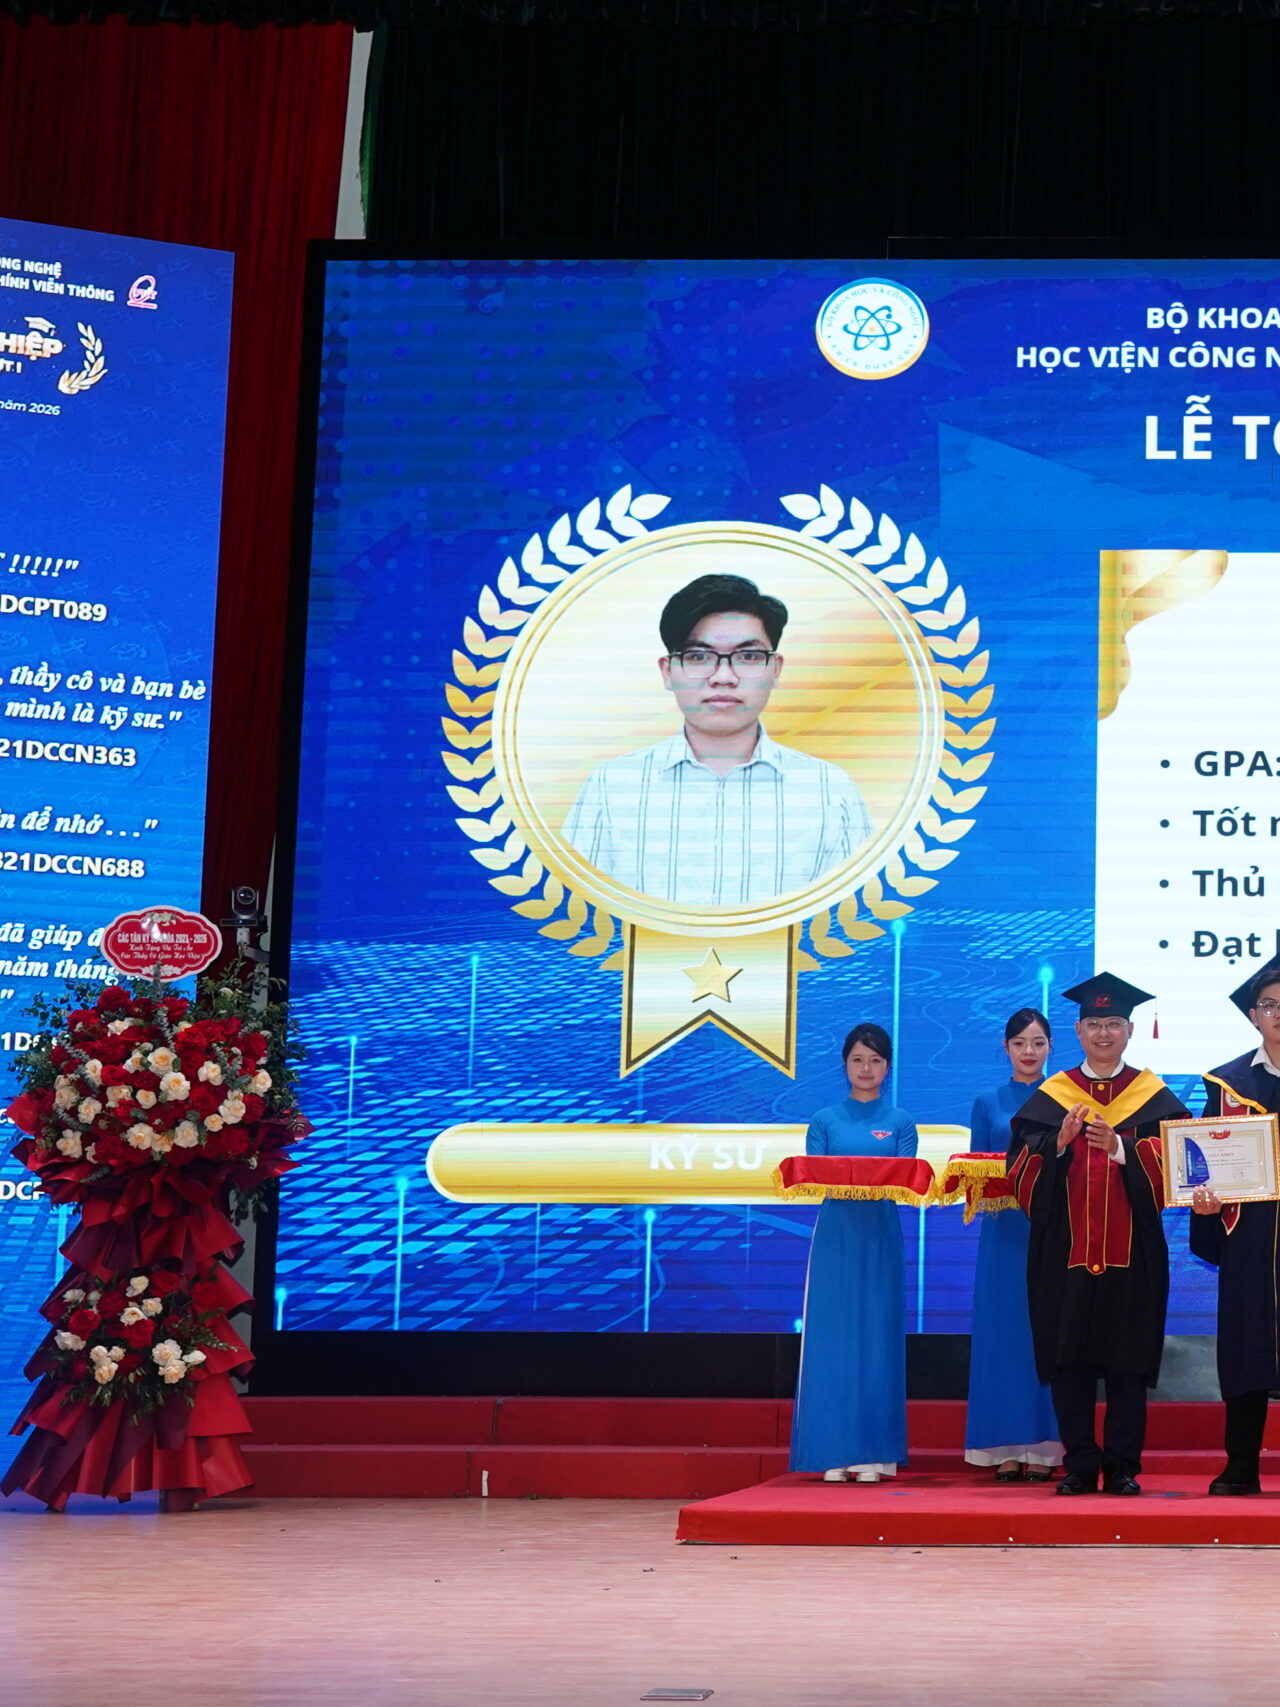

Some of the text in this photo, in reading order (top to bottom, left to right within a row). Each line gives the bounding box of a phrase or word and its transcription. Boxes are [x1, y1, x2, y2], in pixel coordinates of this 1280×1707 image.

[24, 260, 62, 279] NGHỆ
[67, 284, 115, 302] THÔNG
[1146, 302, 1188, 334] BỘ
[1016, 346, 1081, 373] HỌC
[1087, 341, 1159, 373] VIỆN
[1169, 340, 1256, 368] CÔNG
[28, 402, 60, 415] 2026
[1145, 395, 1213, 460] LỄ
[9, 661, 62, 692] thầy
[66, 670, 94, 690] cô
[99, 673, 126, 694] và
[131, 675, 174, 700] bạn
[179, 679, 207, 700] bè
[4, 697, 66, 721] mình
[71, 702, 95, 724] là
[99, 705, 129, 730] kỹ
[21, 806, 53, 831] để
[1192, 806, 1256, 837] Tốt
[1192, 865, 1265, 897] Thủ
[28, 924, 83, 951] giúp
[1192, 930, 1261, 965] Đạt
[649, 1133, 771, 1171] KỸ SƯ
